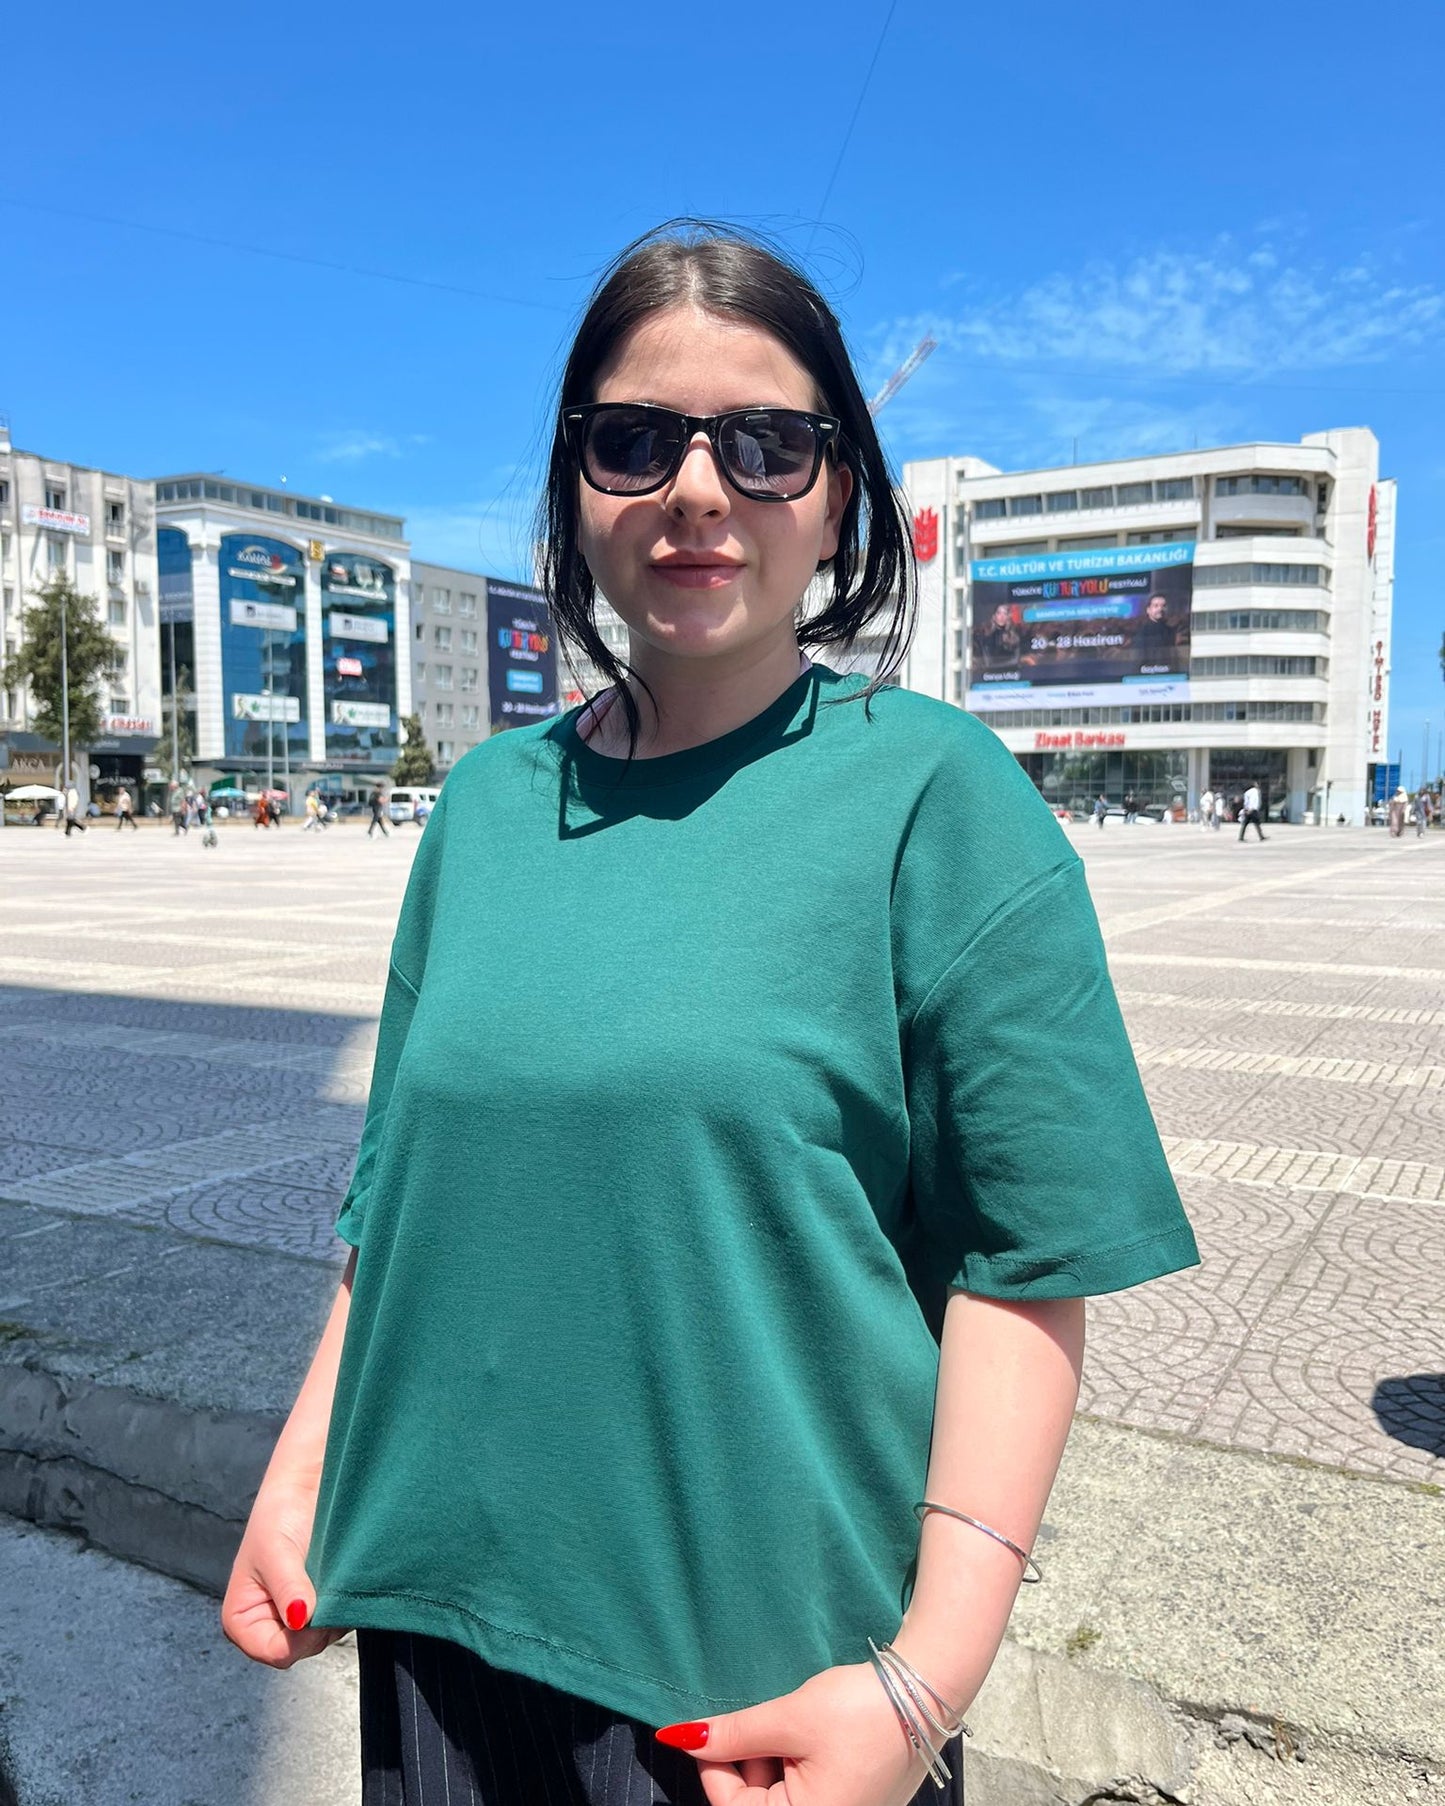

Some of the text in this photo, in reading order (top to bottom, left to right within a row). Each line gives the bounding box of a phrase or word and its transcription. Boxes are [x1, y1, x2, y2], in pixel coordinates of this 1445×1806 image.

[1001, 561, 1046, 576] KÜLTÜR
[1049, 559, 1064, 571] VE
[1067, 554, 1115, 570] TURİZM
[1117, 548, 1188, 567] BAKANLIĞI
[1031, 637, 1048, 649] 20
[1056, 636, 1072, 648] 28
[1073, 634, 1124, 647] Haziran
[1035, 730, 1126, 748] Ziraat Bankası
